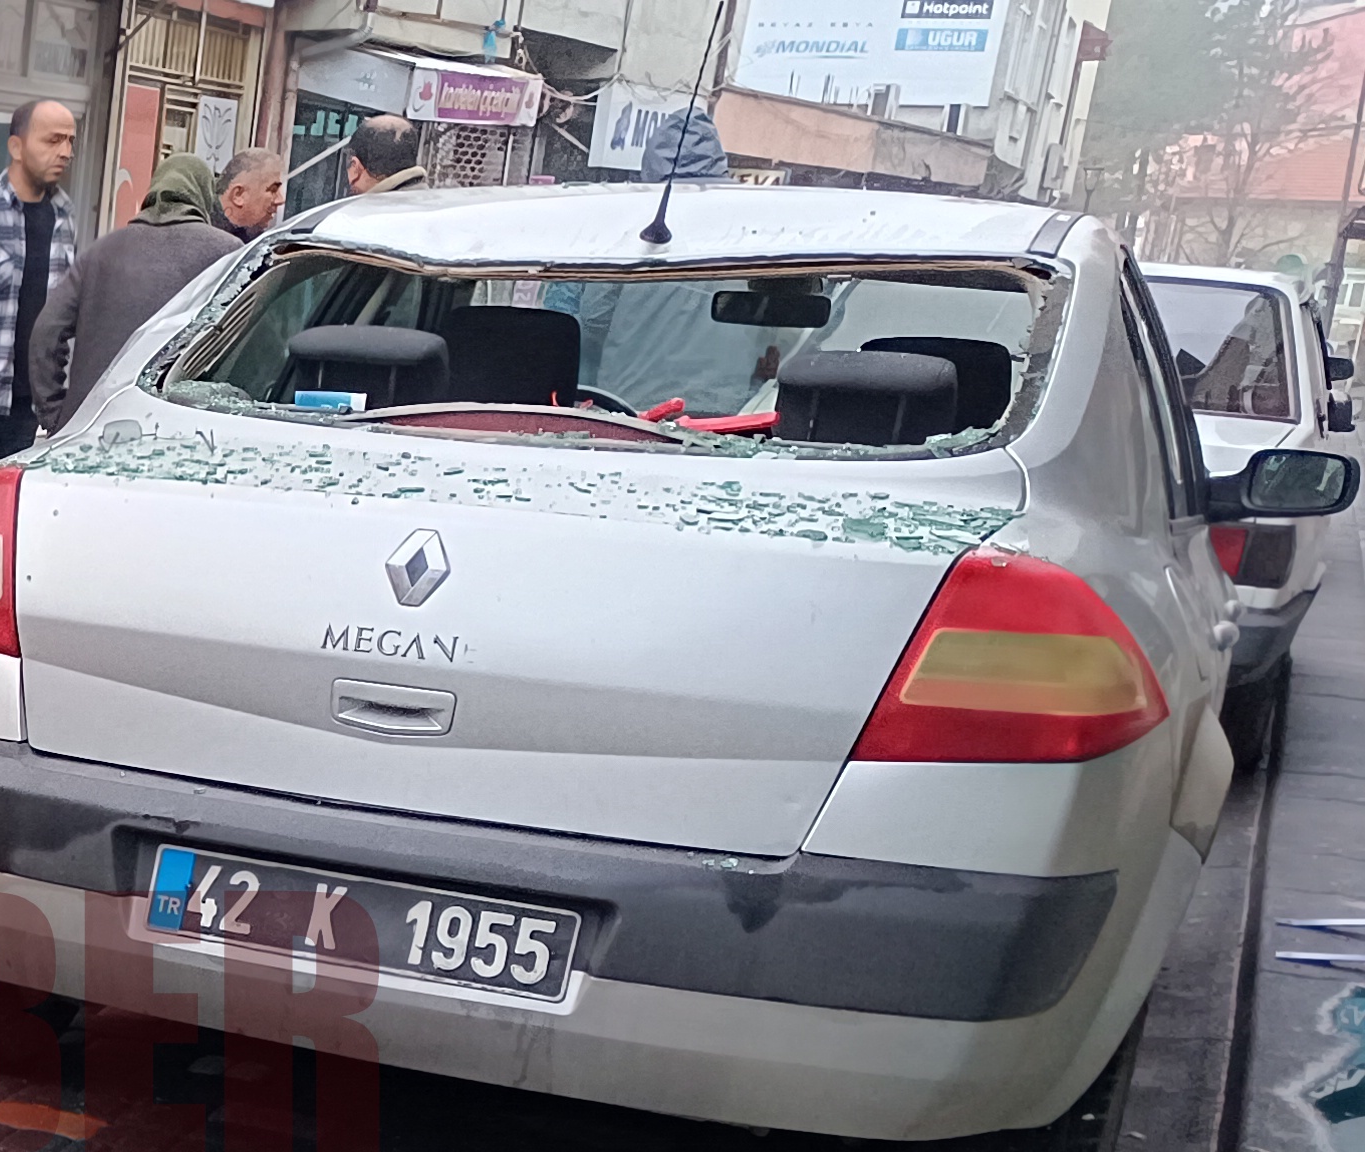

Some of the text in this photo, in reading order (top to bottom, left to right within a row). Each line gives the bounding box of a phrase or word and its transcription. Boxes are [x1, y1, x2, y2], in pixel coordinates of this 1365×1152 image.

[922, 1, 989, 17] Hotpoint
[320, 623, 475, 663] MEGAN
[157, 894, 181, 915] TR
[187, 865, 557, 985] 42 K 1955
